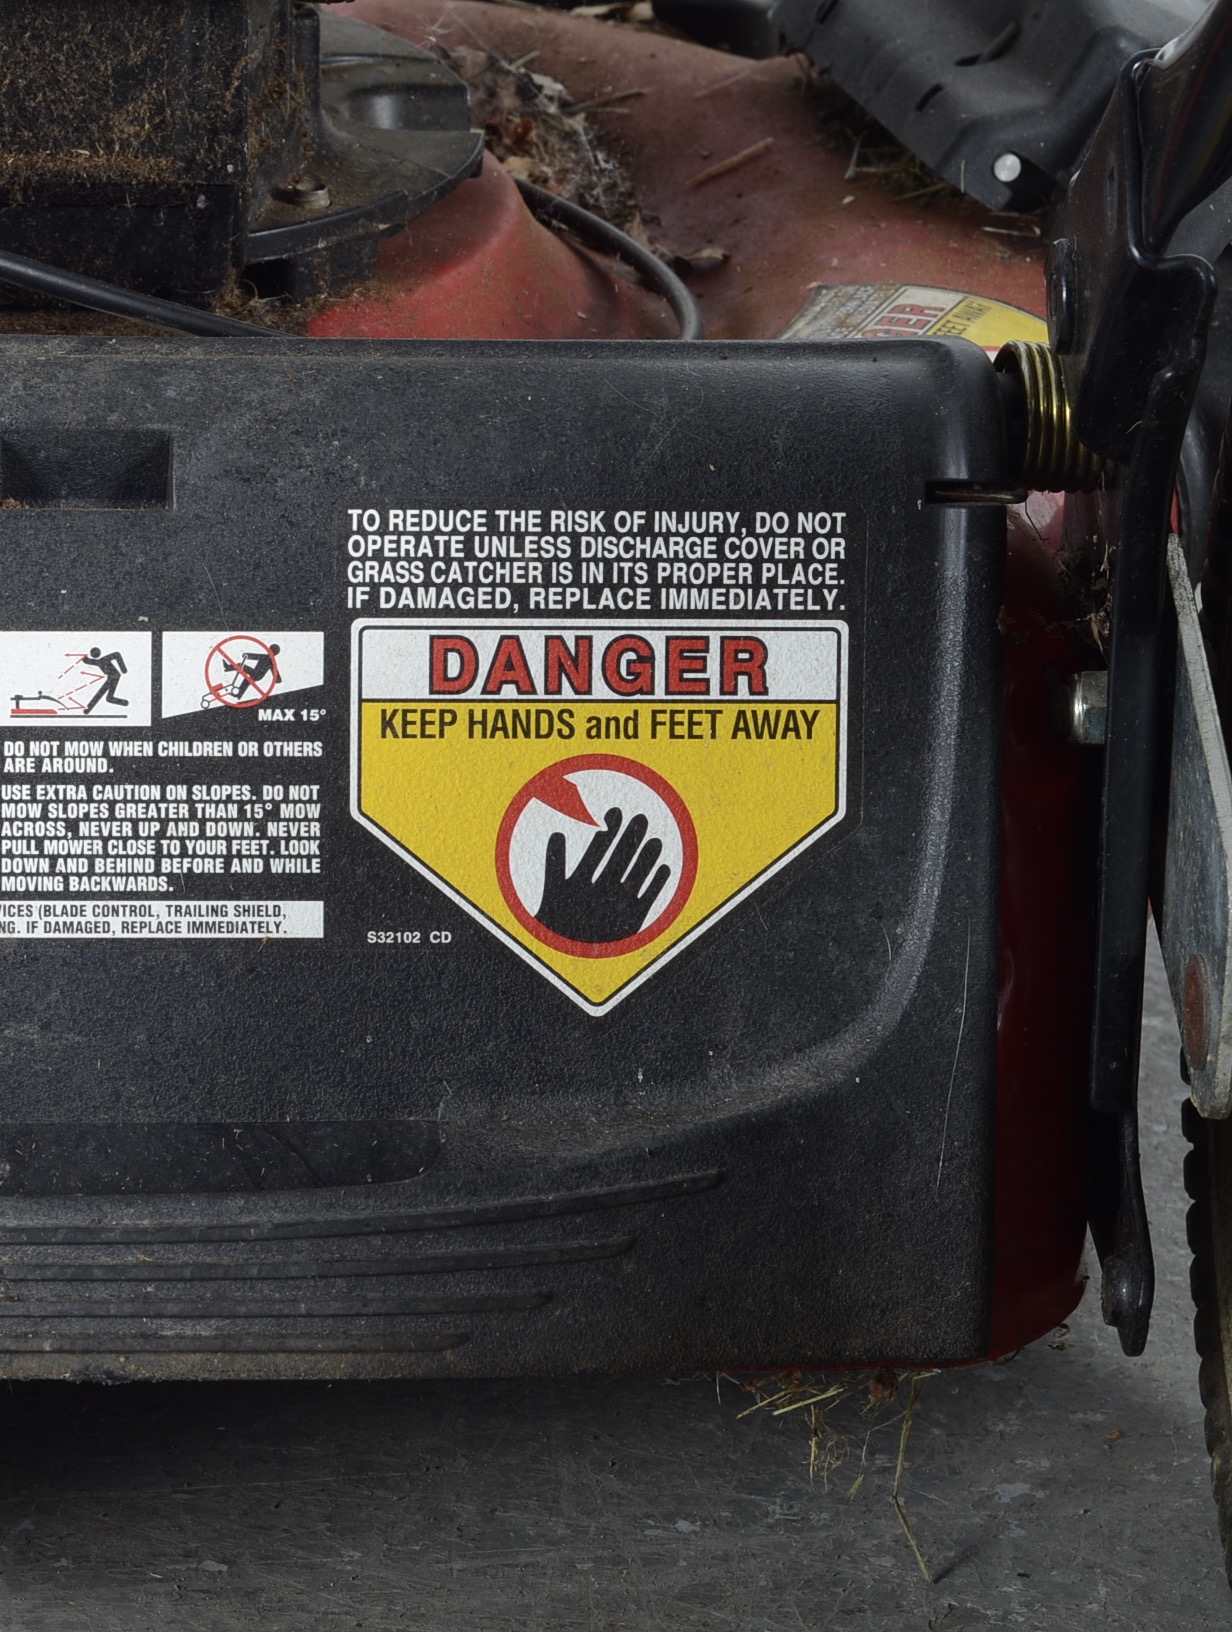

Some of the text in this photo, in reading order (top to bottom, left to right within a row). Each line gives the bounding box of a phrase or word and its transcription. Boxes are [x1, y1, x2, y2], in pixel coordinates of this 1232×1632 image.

[863, 303, 946, 338] GER
[348, 510, 846, 537] TO REDUCE THE RISK OF INJURY, DO NOT
[348, 536, 845, 559] OPERATE UNLESS DISCHARGE COVER OR
[347, 561, 844, 585] GRASS CATCHER IS IN ITS PROPER PLACE.
[348, 587, 845, 612] IF DAMAGED, REPLACE IMMEDIATELY.
[429, 634, 769, 697] DANGER
[258, 709, 326, 721] MAX 15°
[381, 709, 820, 739] KEEP HANDS and FEET AWAY
[4, 741, 322, 758] DO NOT MOW WHEN CHILDREN OR OTHERS
[4, 758, 113, 773] ARE AROUND.
[1, 784, 320, 800] USE EXTRA CAUTION ON SLOPES. DO NOT
[1, 803, 320, 818] MOW SLOPES GREATER THAN 15° MOW
[1, 821, 320, 838] ACROSS, NEVER UP AND DOWN. NEVER
[2, 839, 320, 855] PULL MOWER CLOSE TO YOUR FEET. LOOK
[1, 858, 320, 874] DOWN AND BEHIND BEFORE AND WHILE
[1, 875, 173, 891] MOVING BACKWARDS.
[39, 905, 86, 919] (BLADE
[93, 905, 159, 918] CONTROL,
[166, 905, 228, 917] TRAILING
[234, 905, 285, 919] SHIELD,
[27, 922, 37, 933] IF
[44, 921, 115, 933] DAMAGED,
[122, 921, 181, 933] REPLACE
[188, 921, 286, 933] IMMEDIATELY.
[367, 931, 451, 943] S32102 CD
